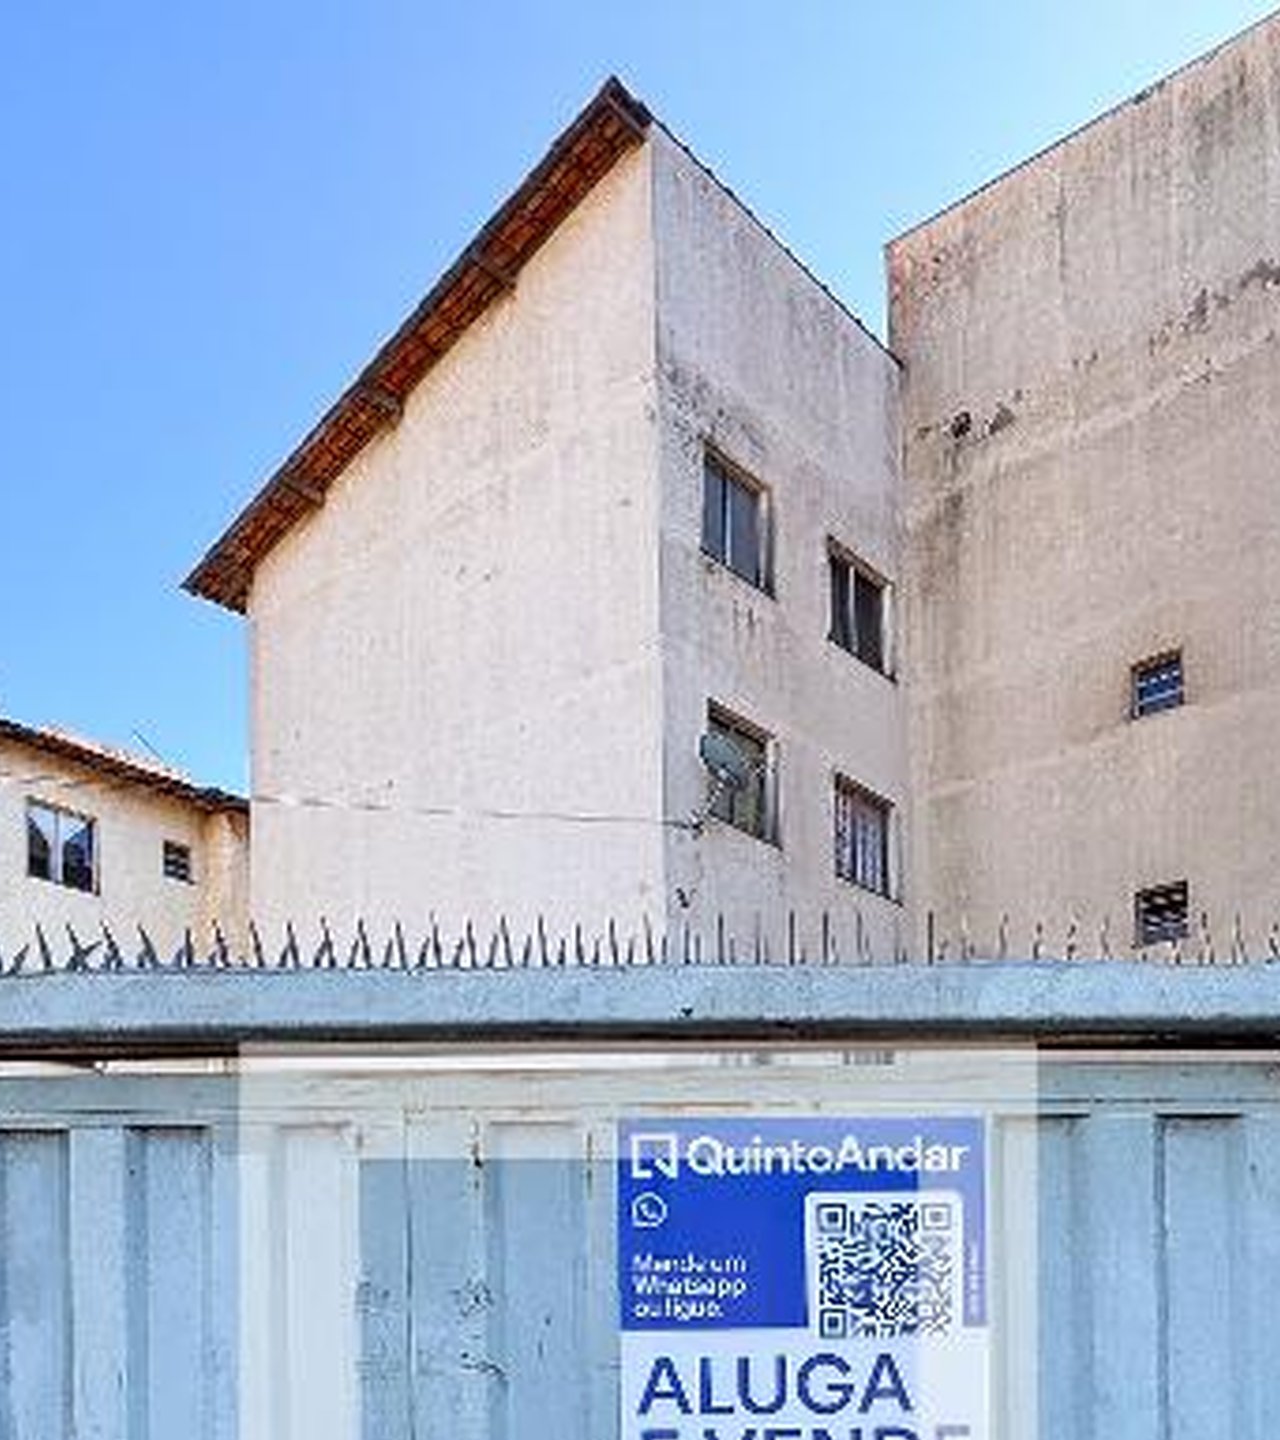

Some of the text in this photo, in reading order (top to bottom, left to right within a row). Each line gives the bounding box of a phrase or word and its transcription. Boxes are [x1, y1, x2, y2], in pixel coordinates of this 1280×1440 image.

[686, 1135, 970, 1175] QuintoAndar
[710, 1258, 747, 1273] um
[634, 1302, 662, 1318] ou
[637, 1353, 915, 1415] ALUGA
